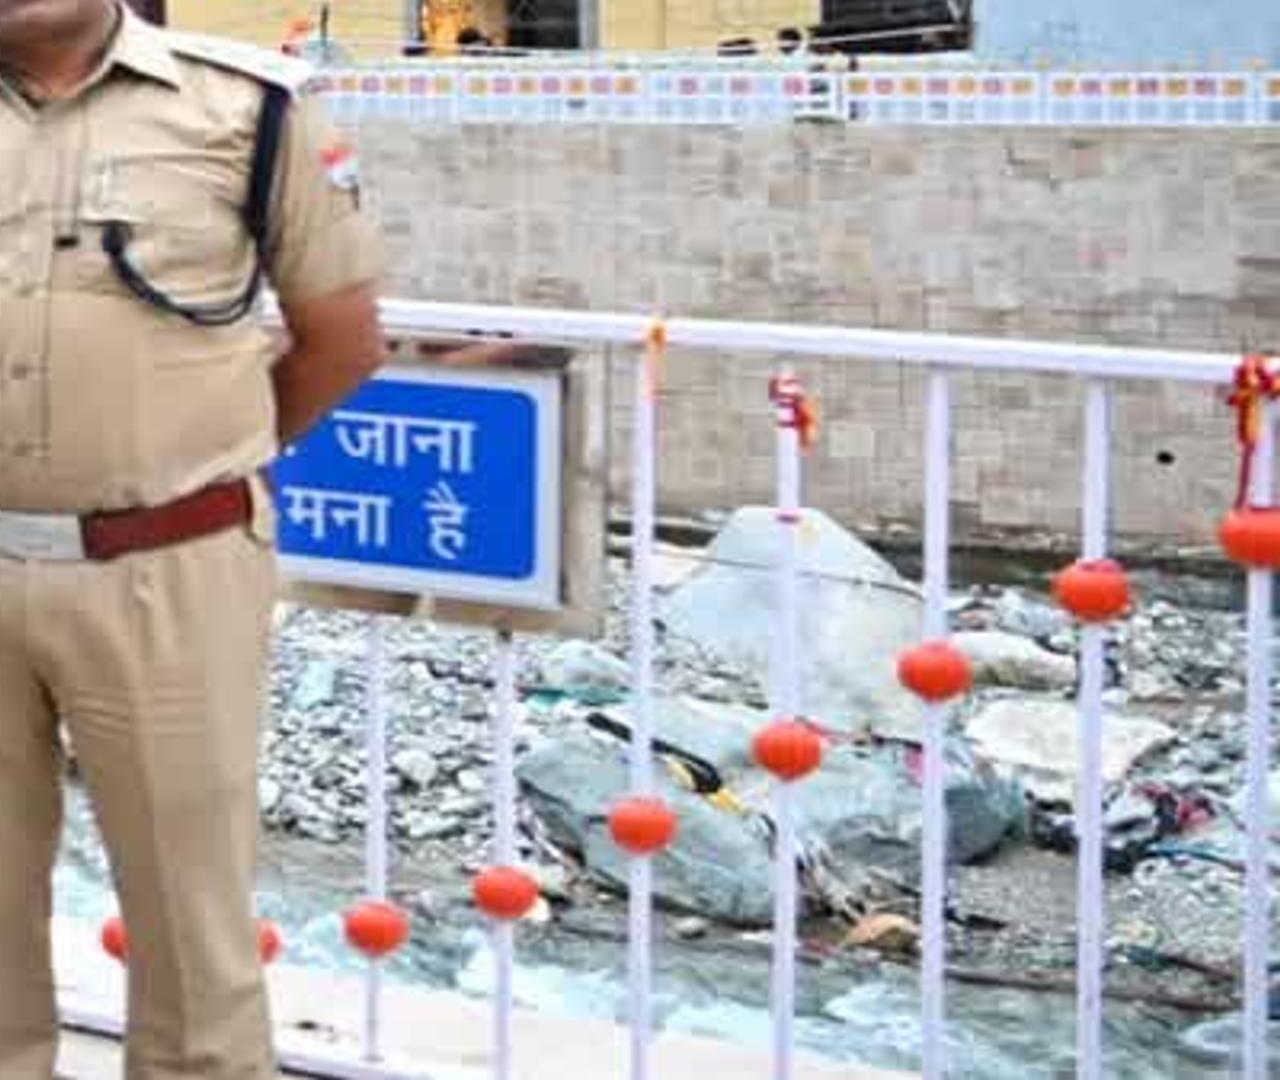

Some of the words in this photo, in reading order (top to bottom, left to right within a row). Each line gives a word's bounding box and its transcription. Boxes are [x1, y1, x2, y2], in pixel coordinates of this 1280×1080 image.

[333, 411, 476, 472] जाना
[282, 487, 392, 547] मना
[424, 481, 469, 560] है
